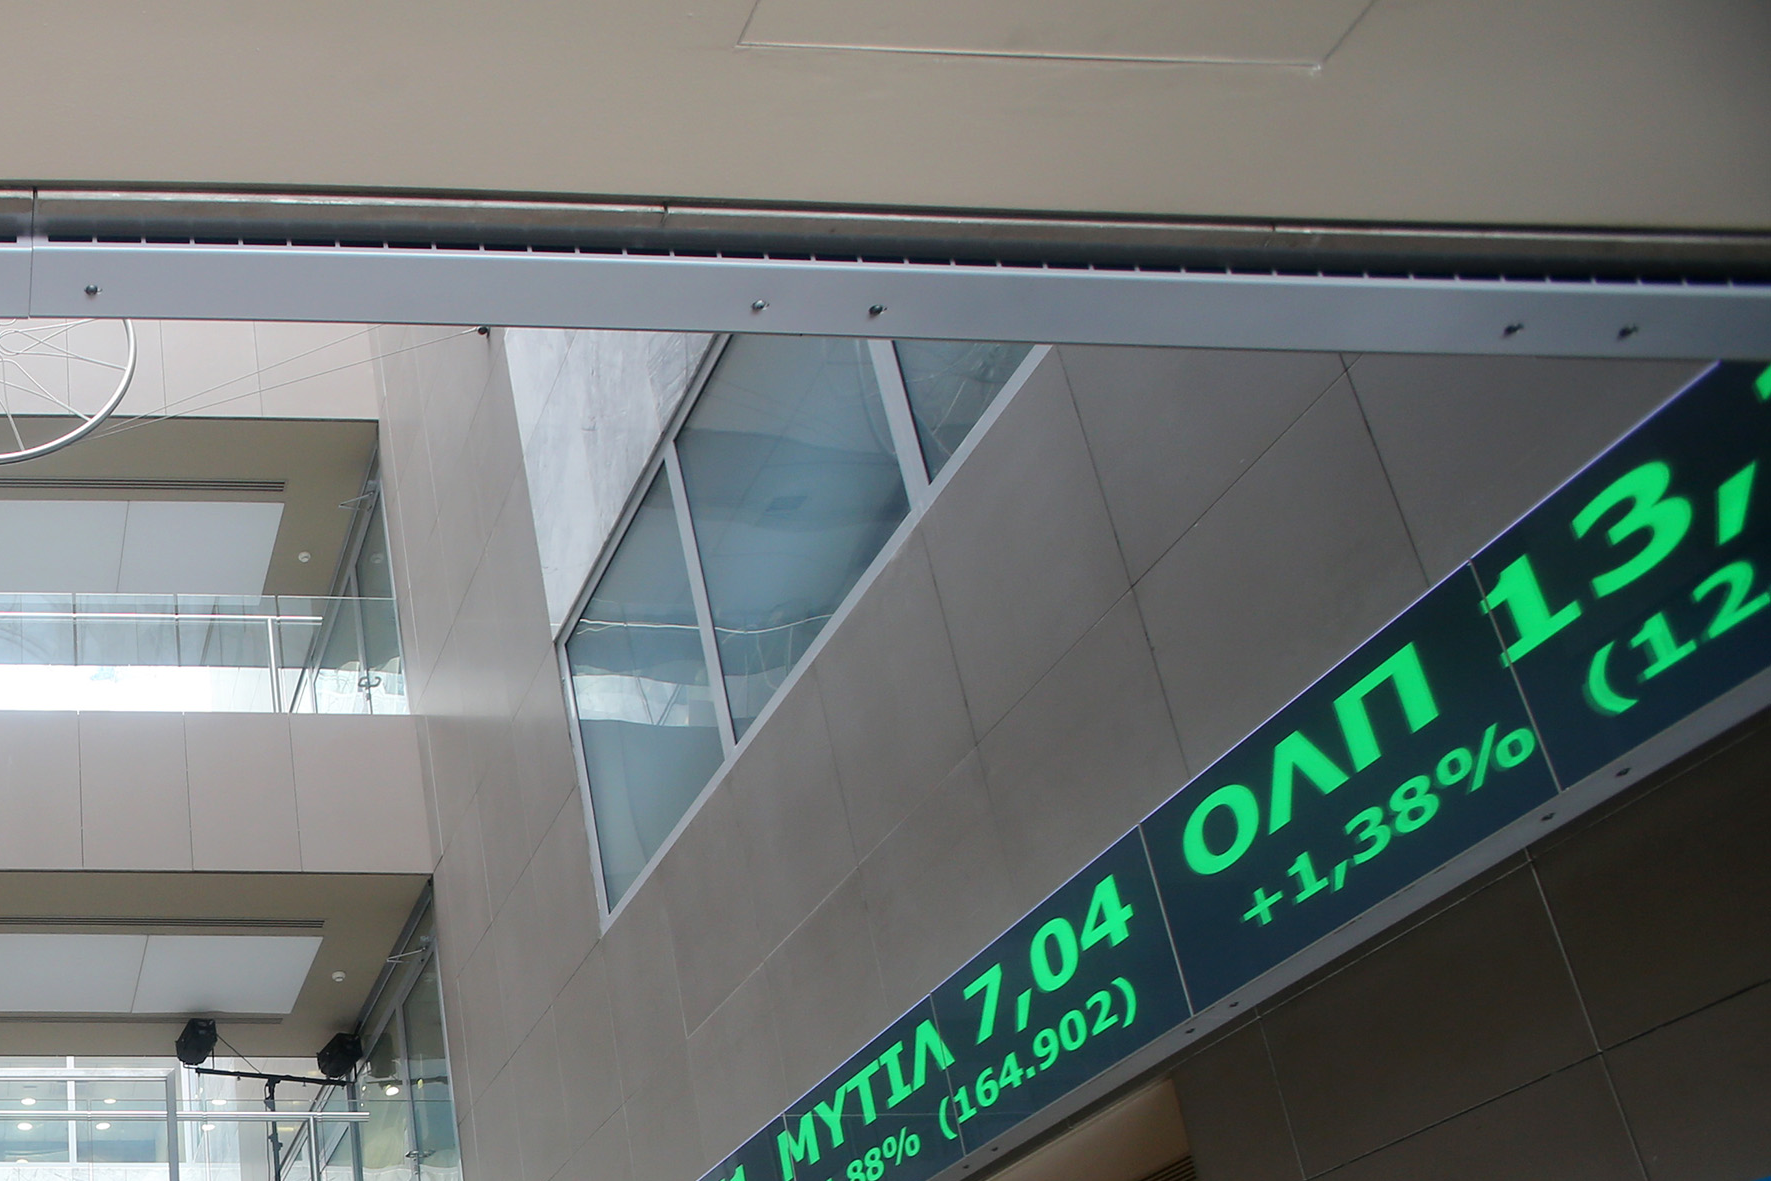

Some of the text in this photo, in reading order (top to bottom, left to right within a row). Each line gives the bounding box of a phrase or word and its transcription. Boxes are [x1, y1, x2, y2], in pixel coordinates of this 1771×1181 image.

[1181, 364, 1771, 876] ΟΛΠ 13,
[1240, 722, 1537, 926] +1,38%
[962, 872, 1135, 1046] 7,04
[937, 976, 1138, 1141] (164.902)
